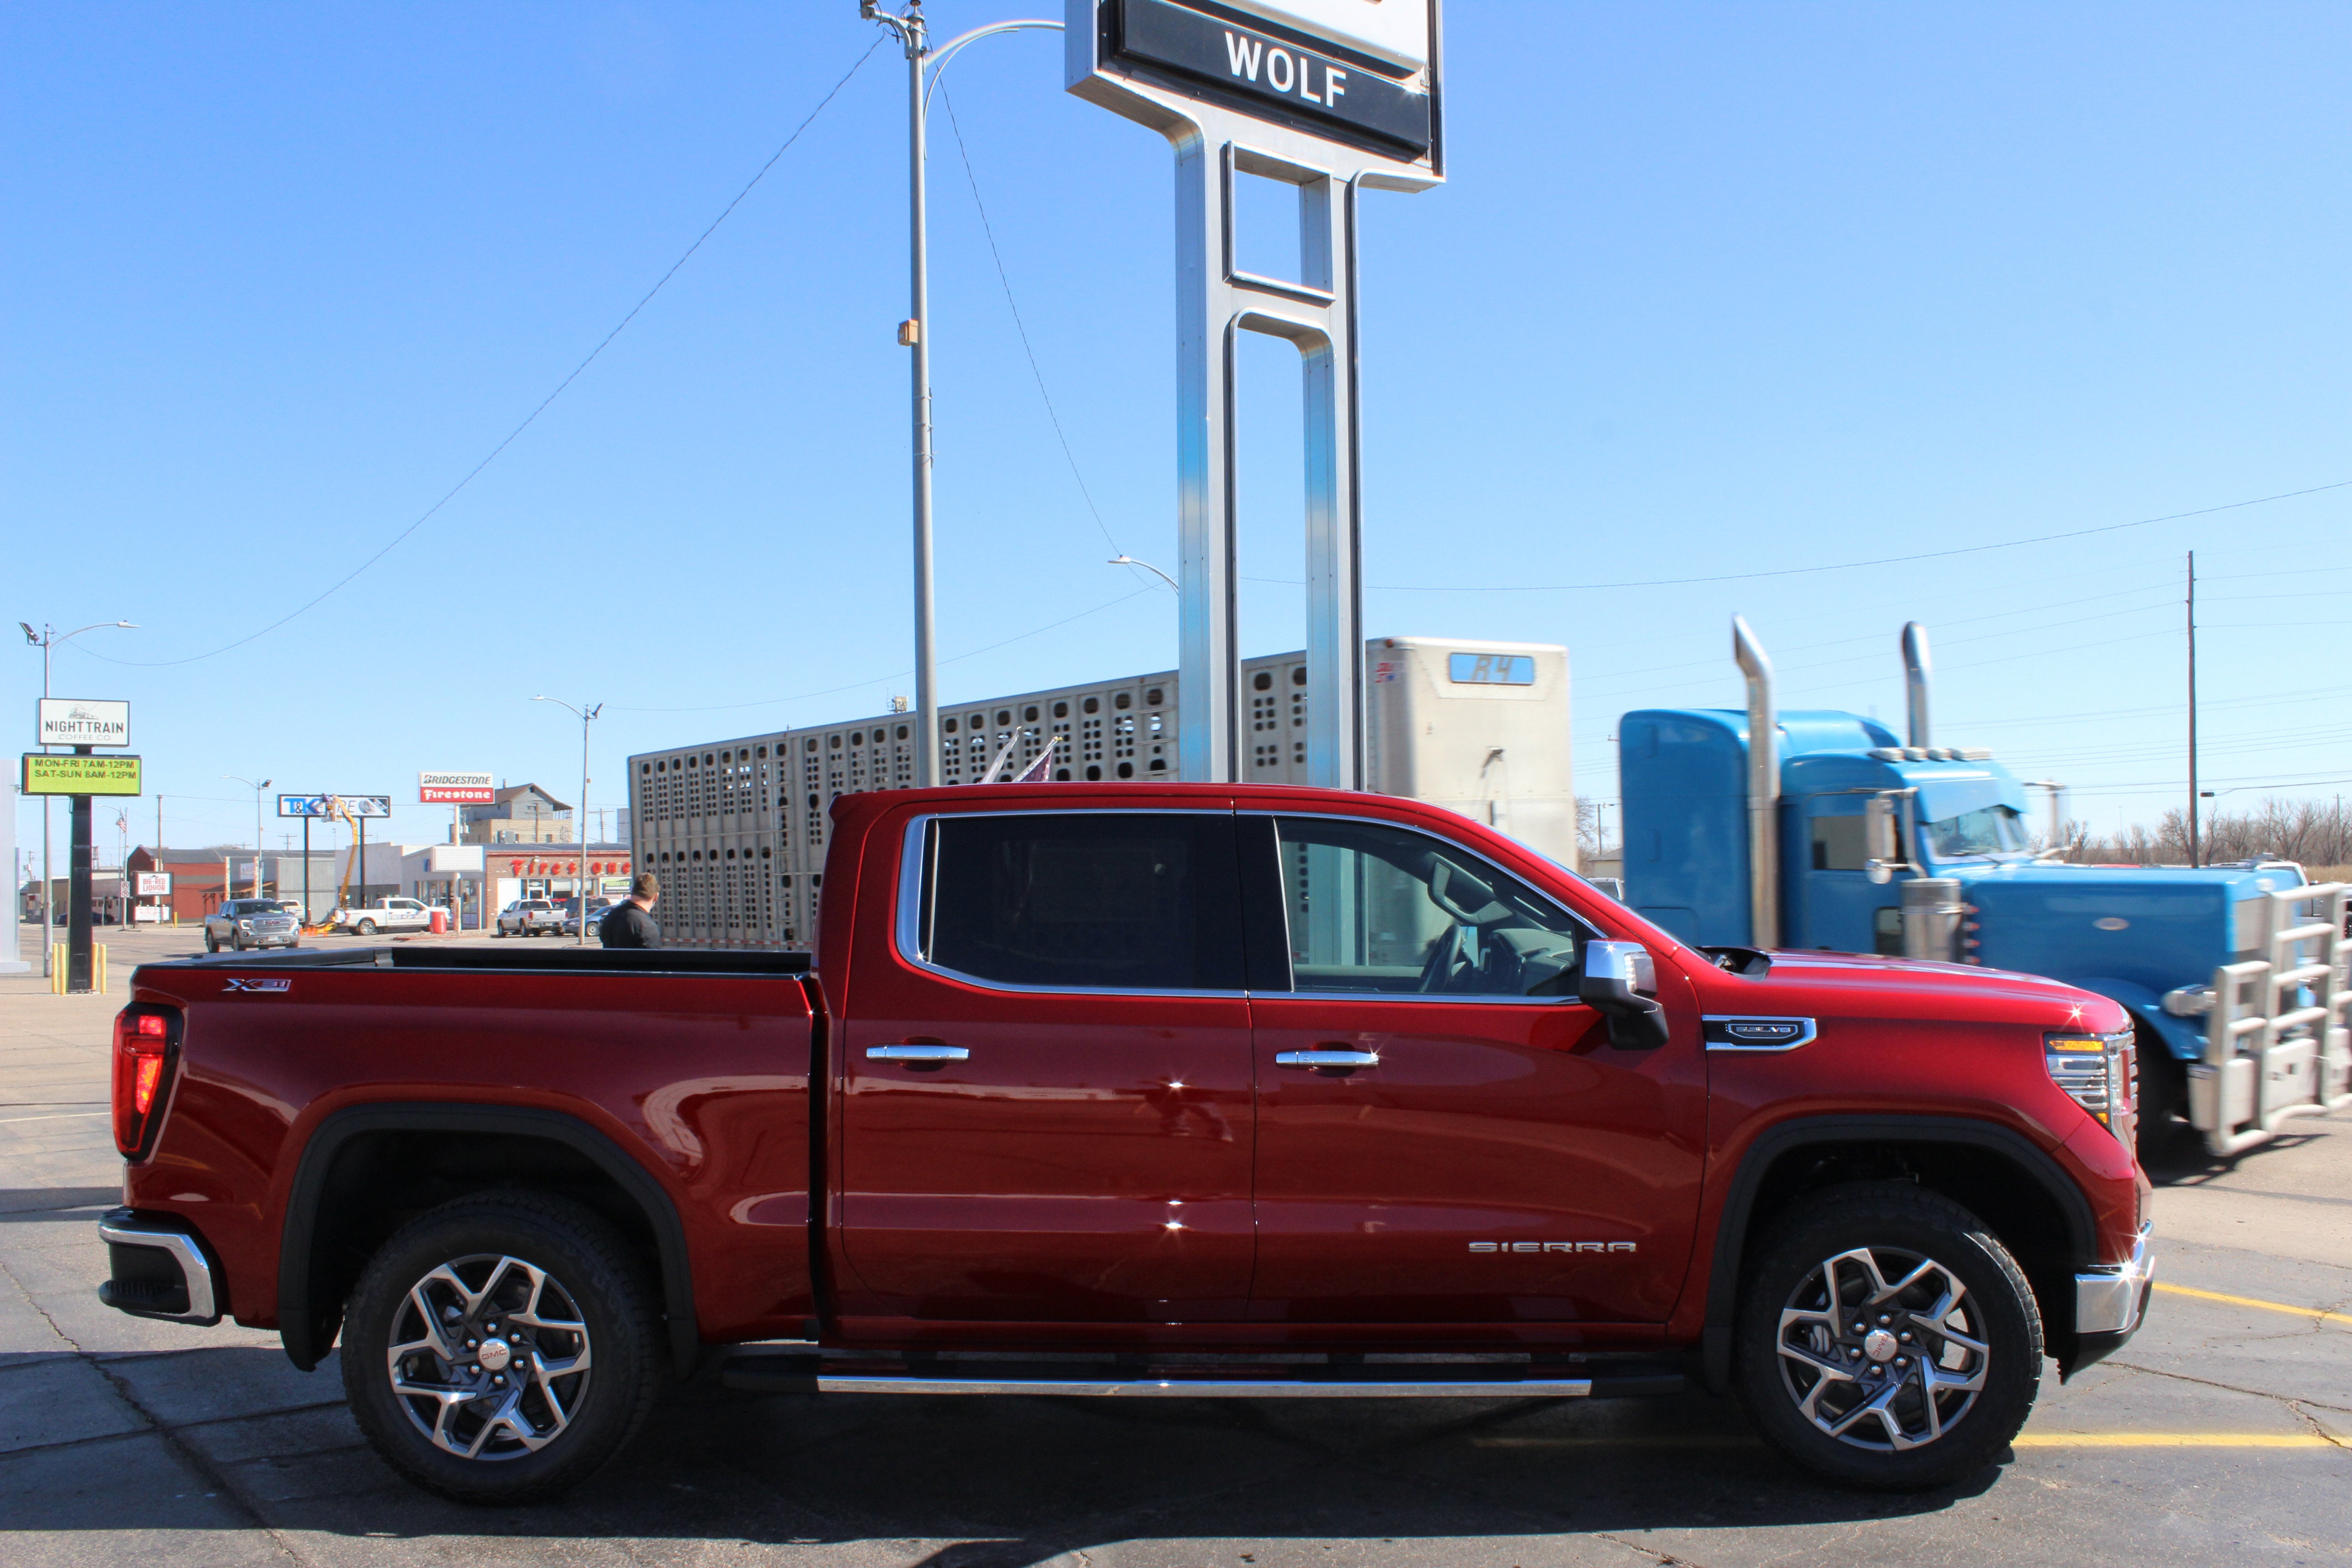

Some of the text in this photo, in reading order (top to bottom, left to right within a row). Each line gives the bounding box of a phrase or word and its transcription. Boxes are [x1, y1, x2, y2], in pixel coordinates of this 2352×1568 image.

[1225, 31, 1346, 108] WOLF
[45, 720, 124, 733] NIGHT TRAIN
[34, 759, 80, 767] MON-FRI
[423, 775, 491, 784] BRIDGESTONE
[424, 789, 490, 800] Firestone
[283, 798, 322, 813] T&K
[510, 859, 631, 877] Firesone
[1469, 1241, 1637, 1253] SIERRA
[1872, 1333, 1889, 1357] GMC
[482, 1348, 507, 1359] GMC
